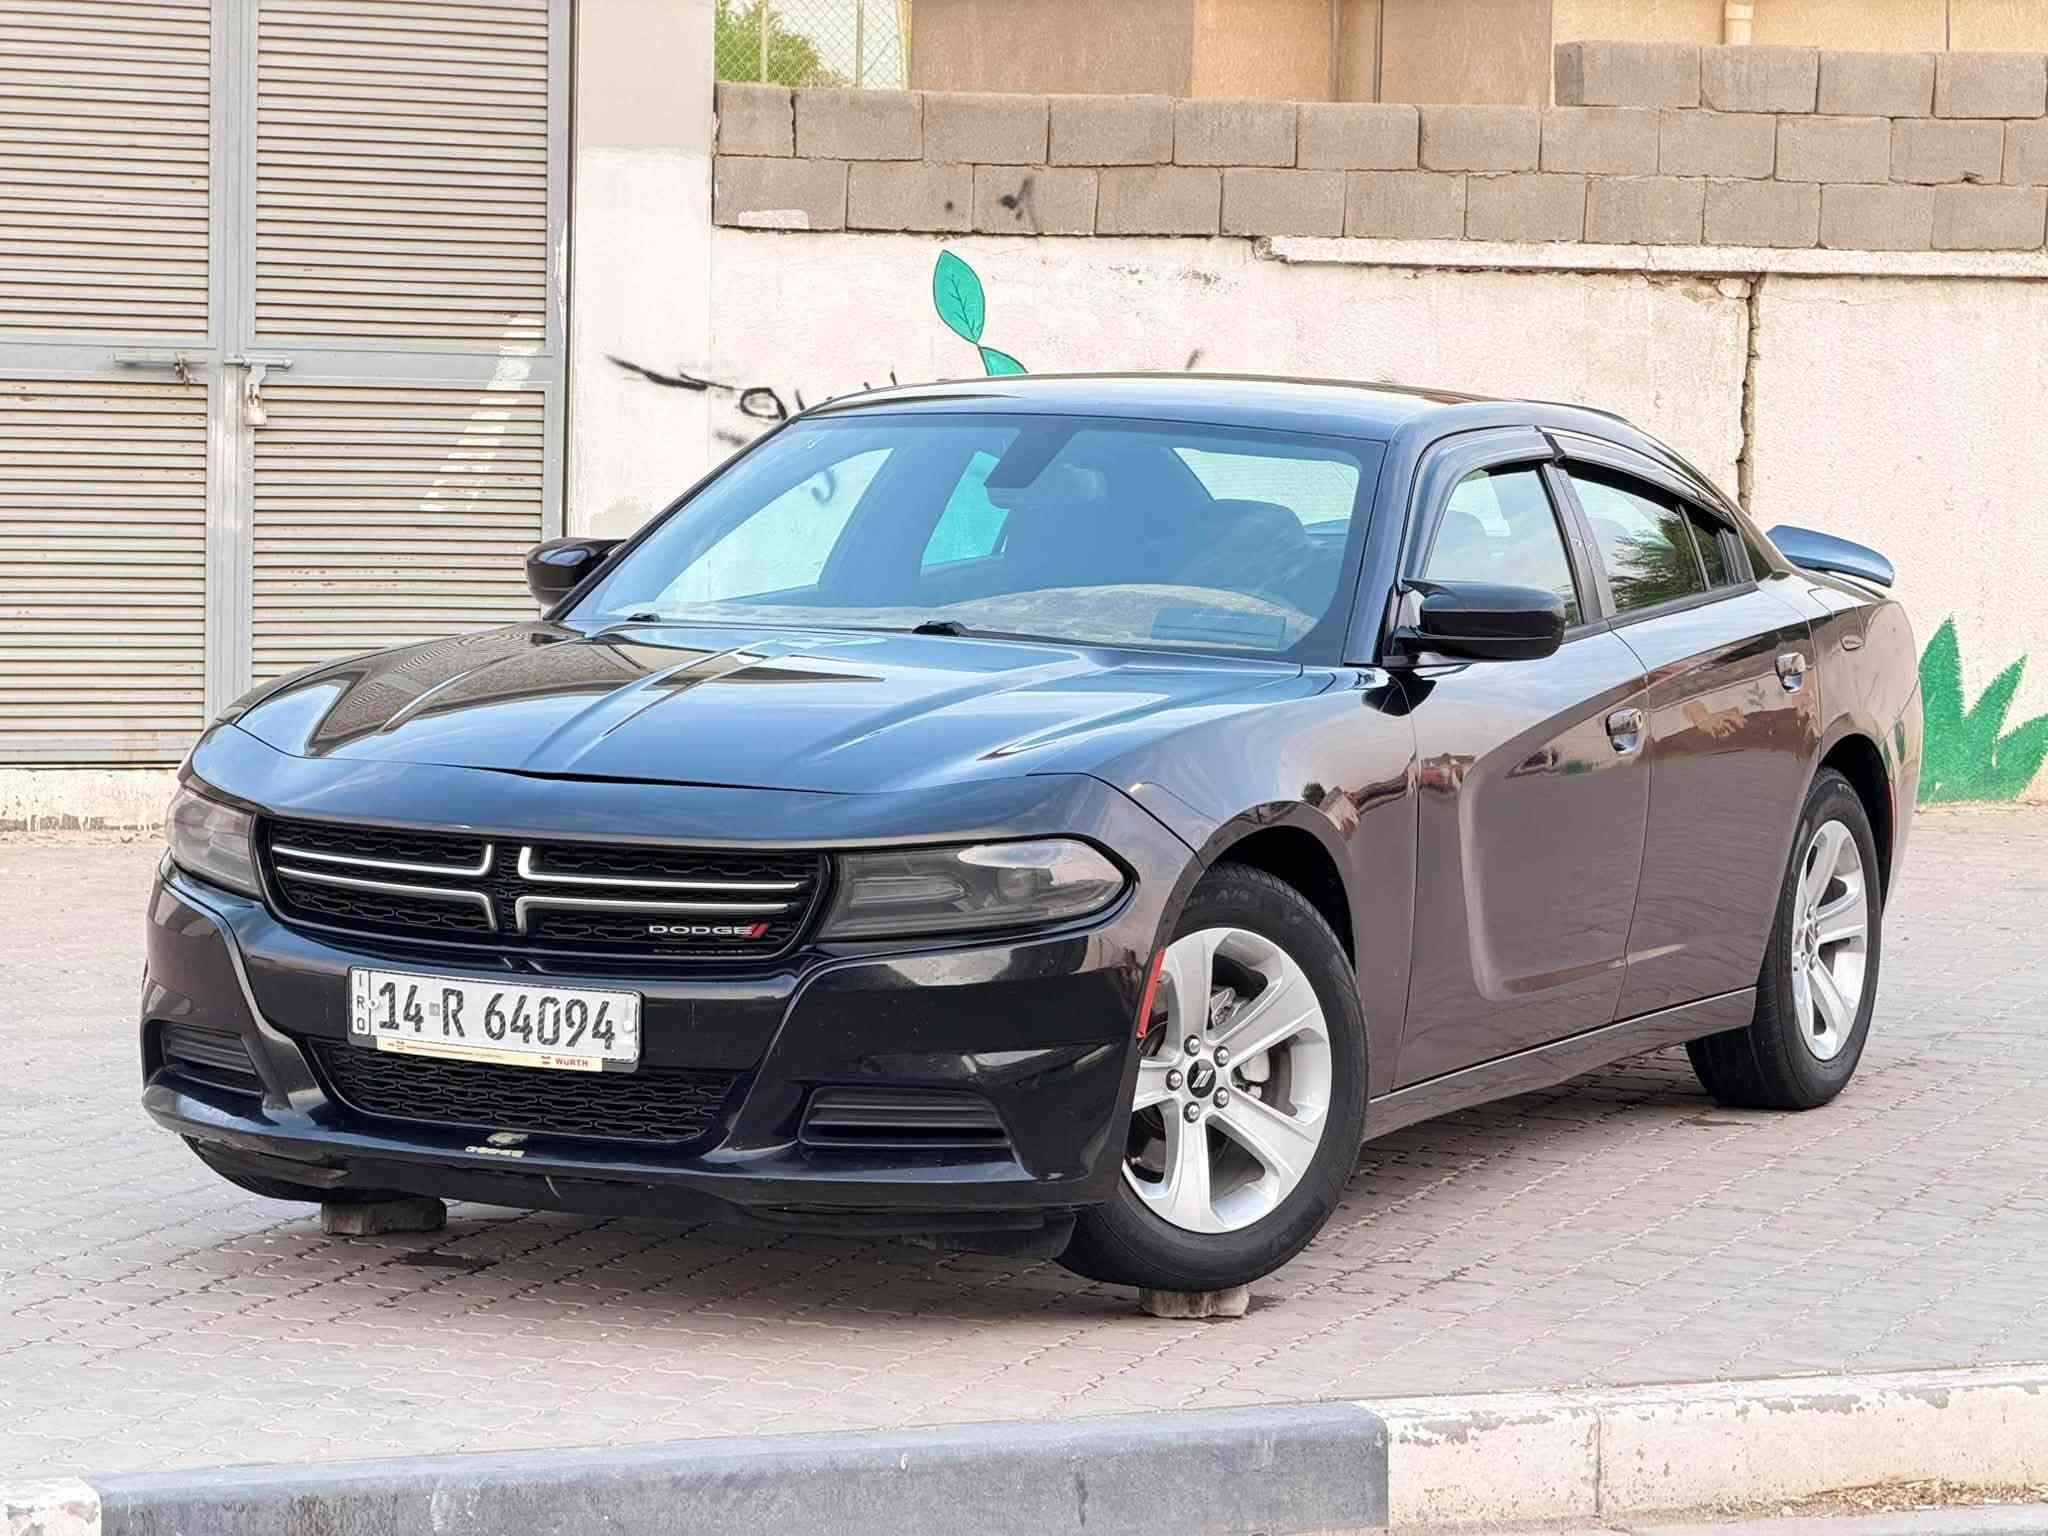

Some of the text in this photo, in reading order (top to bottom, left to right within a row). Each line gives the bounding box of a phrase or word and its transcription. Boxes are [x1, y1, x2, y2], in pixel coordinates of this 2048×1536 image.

[649, 925, 753, 935] DODGE
[379, 981, 616, 1050] 14 R 64094
